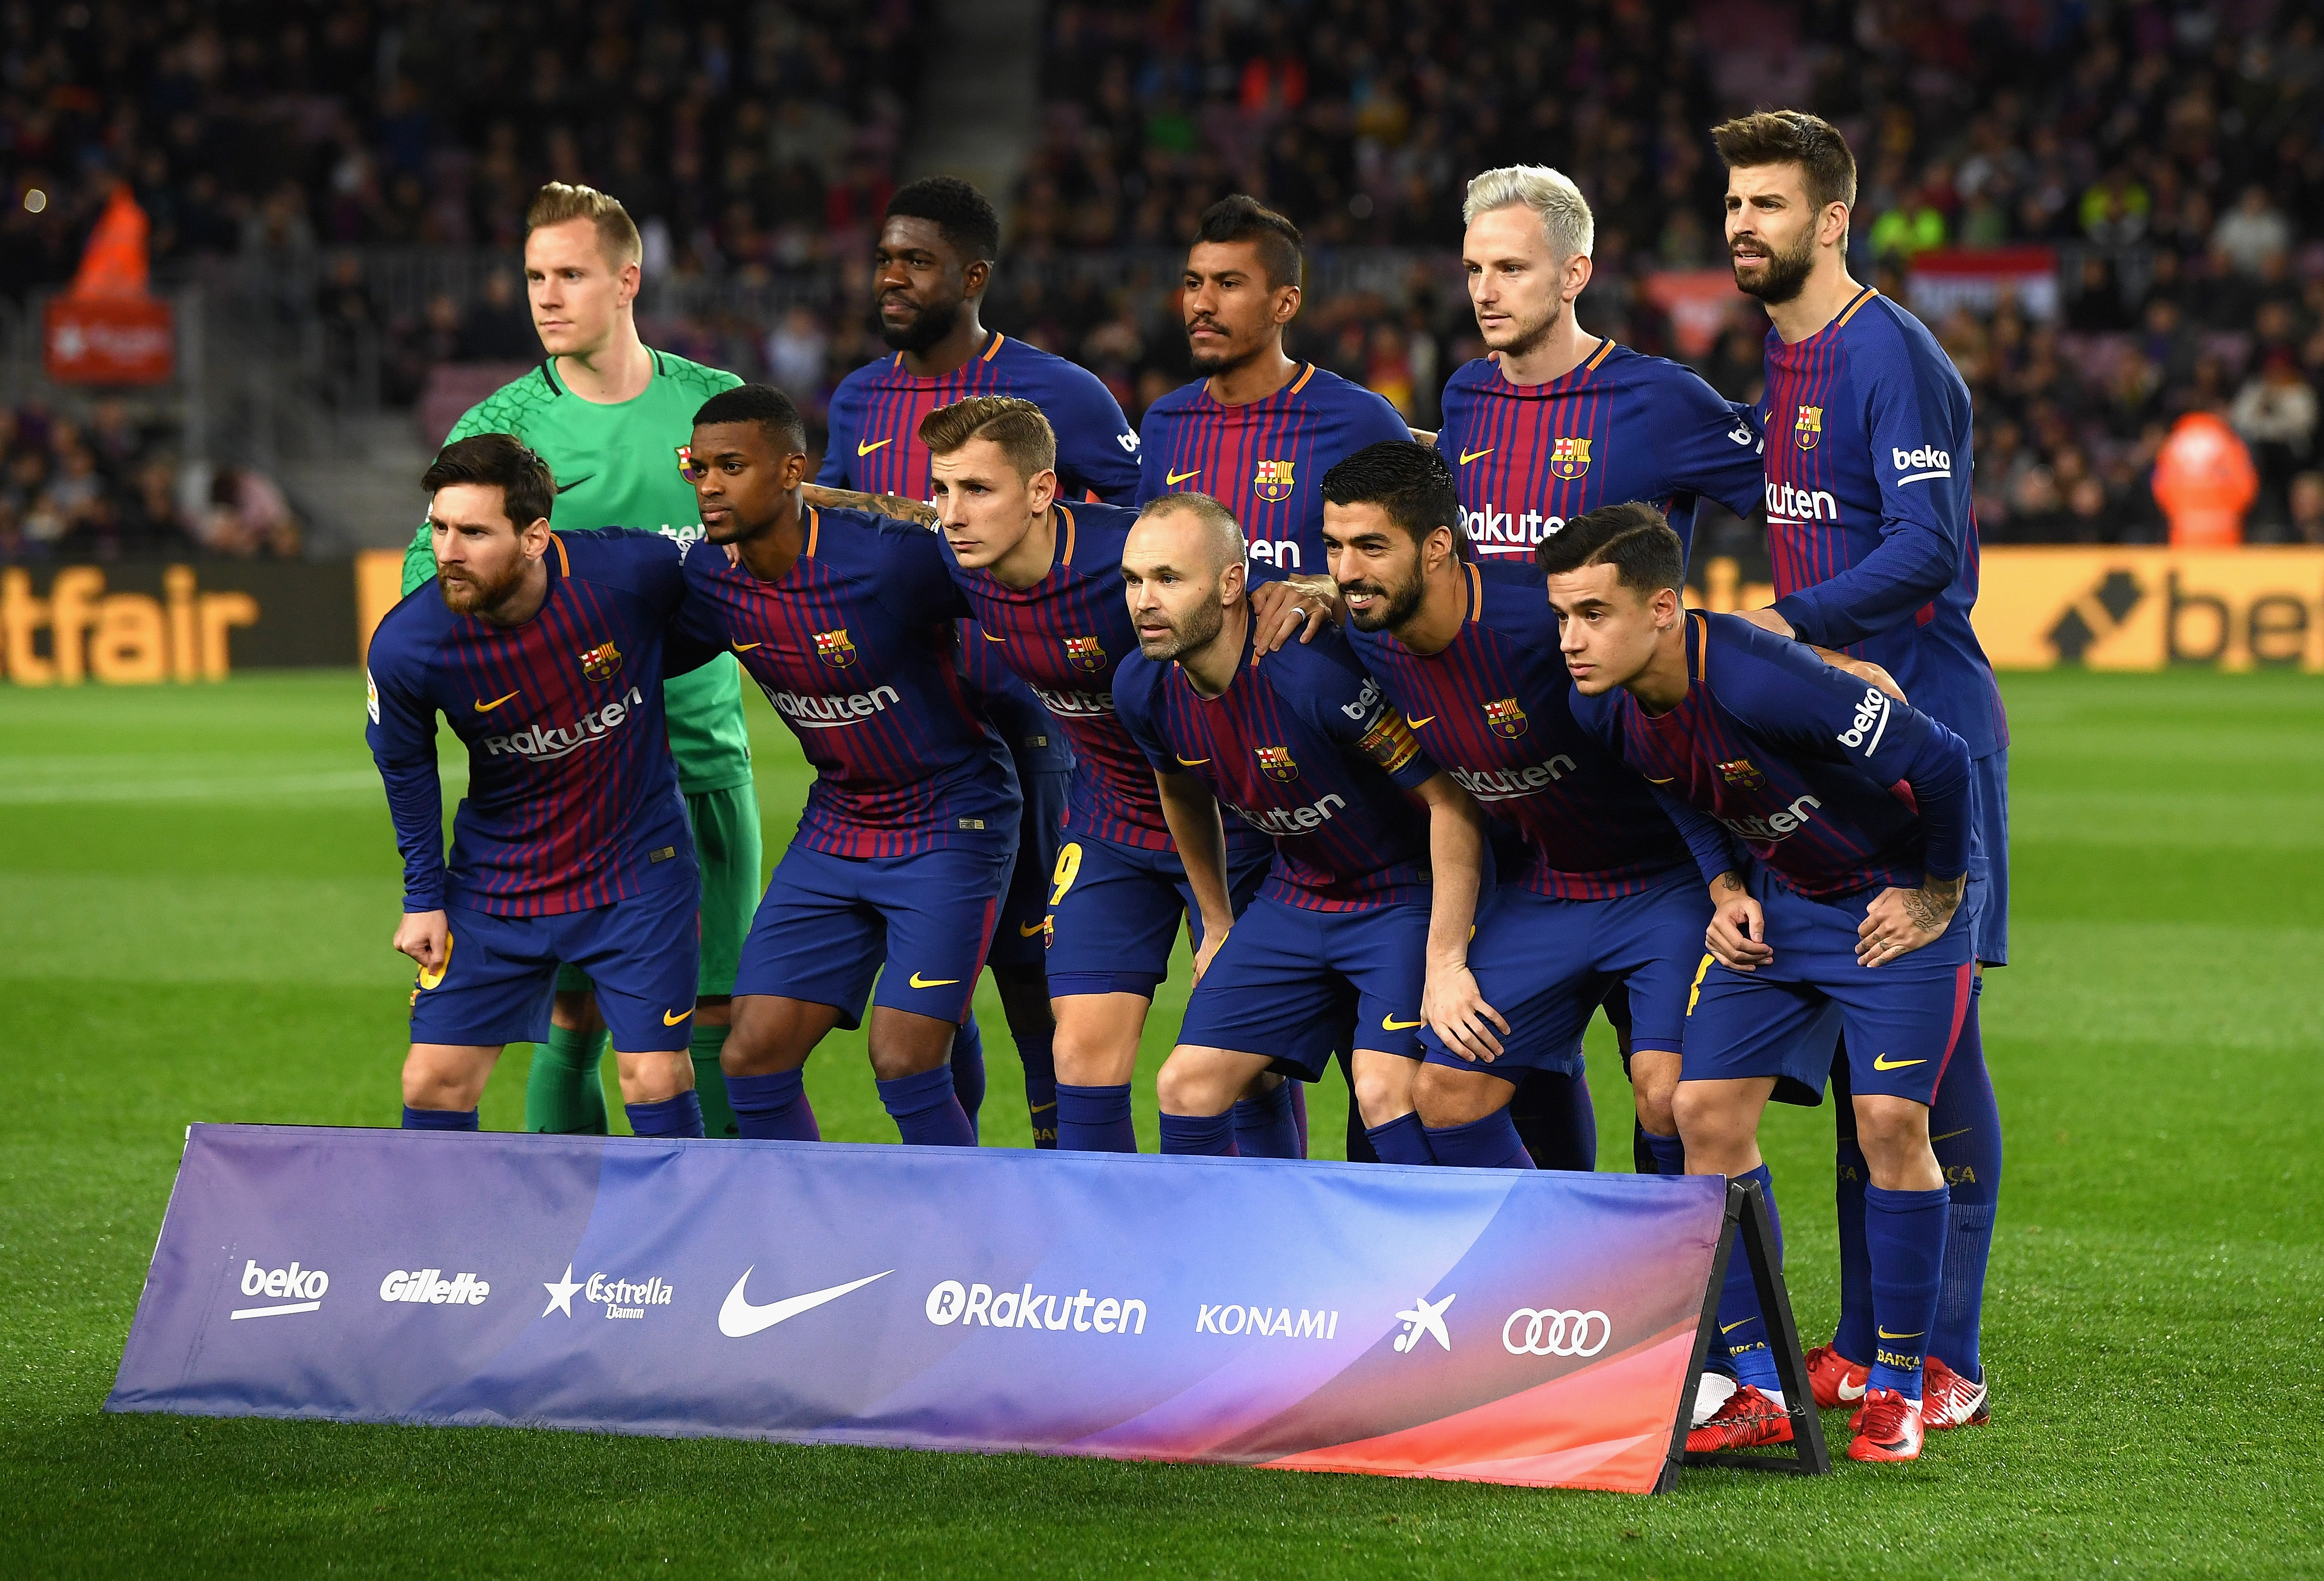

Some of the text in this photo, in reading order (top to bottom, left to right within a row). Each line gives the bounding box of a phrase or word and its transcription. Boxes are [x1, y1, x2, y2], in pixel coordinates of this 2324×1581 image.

[1892, 445, 1950, 470] beko
[483, 686, 642, 755] Rakuten
[1837, 688, 1883, 747] beko
[241, 1260, 329, 1299] beko
[380, 1269, 490, 1305] Gillette
[585, 1272, 673, 1305] Estrella
[605, 1303, 645, 1319] Damm
[962, 1283, 1147, 1334] Rakuten
[1195, 1304, 1338, 1339] KONAMI
[1877, 1348, 1920, 1371] BARÇA
